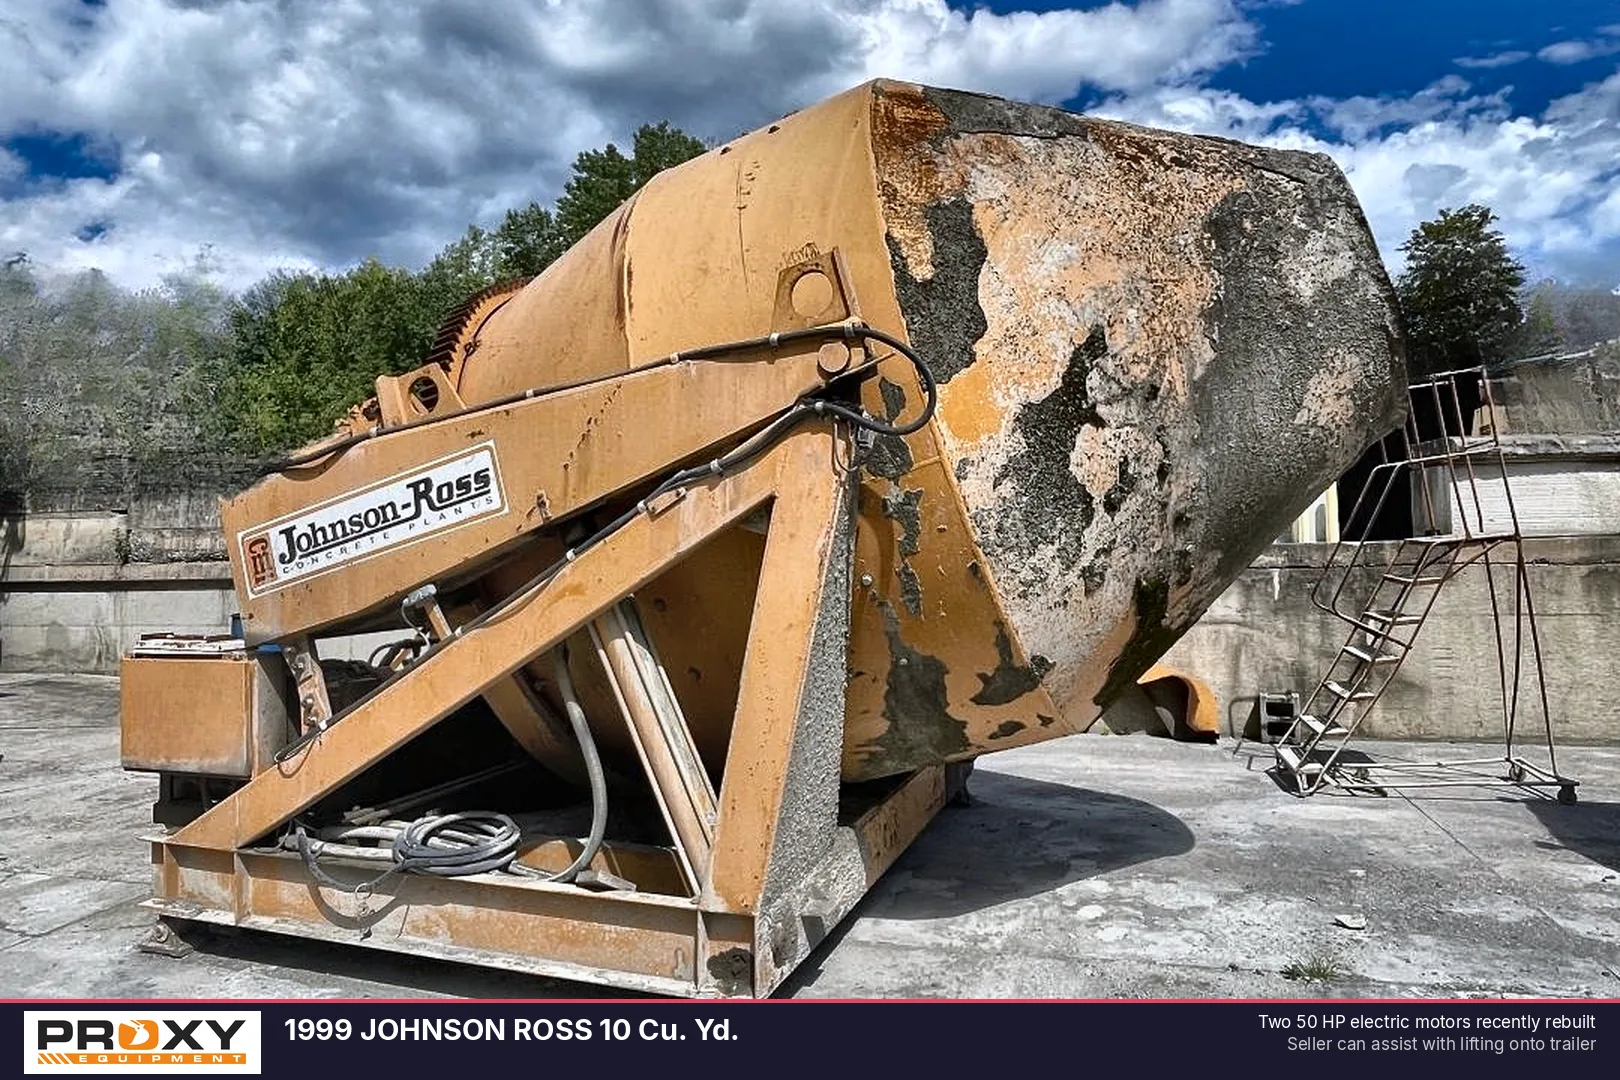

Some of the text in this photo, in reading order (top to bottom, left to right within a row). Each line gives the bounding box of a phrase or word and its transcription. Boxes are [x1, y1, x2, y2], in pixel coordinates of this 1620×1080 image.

[279, 467, 491, 565] Johnson-Ross
[283, 495, 494, 575] CONCRETE PLANTS
